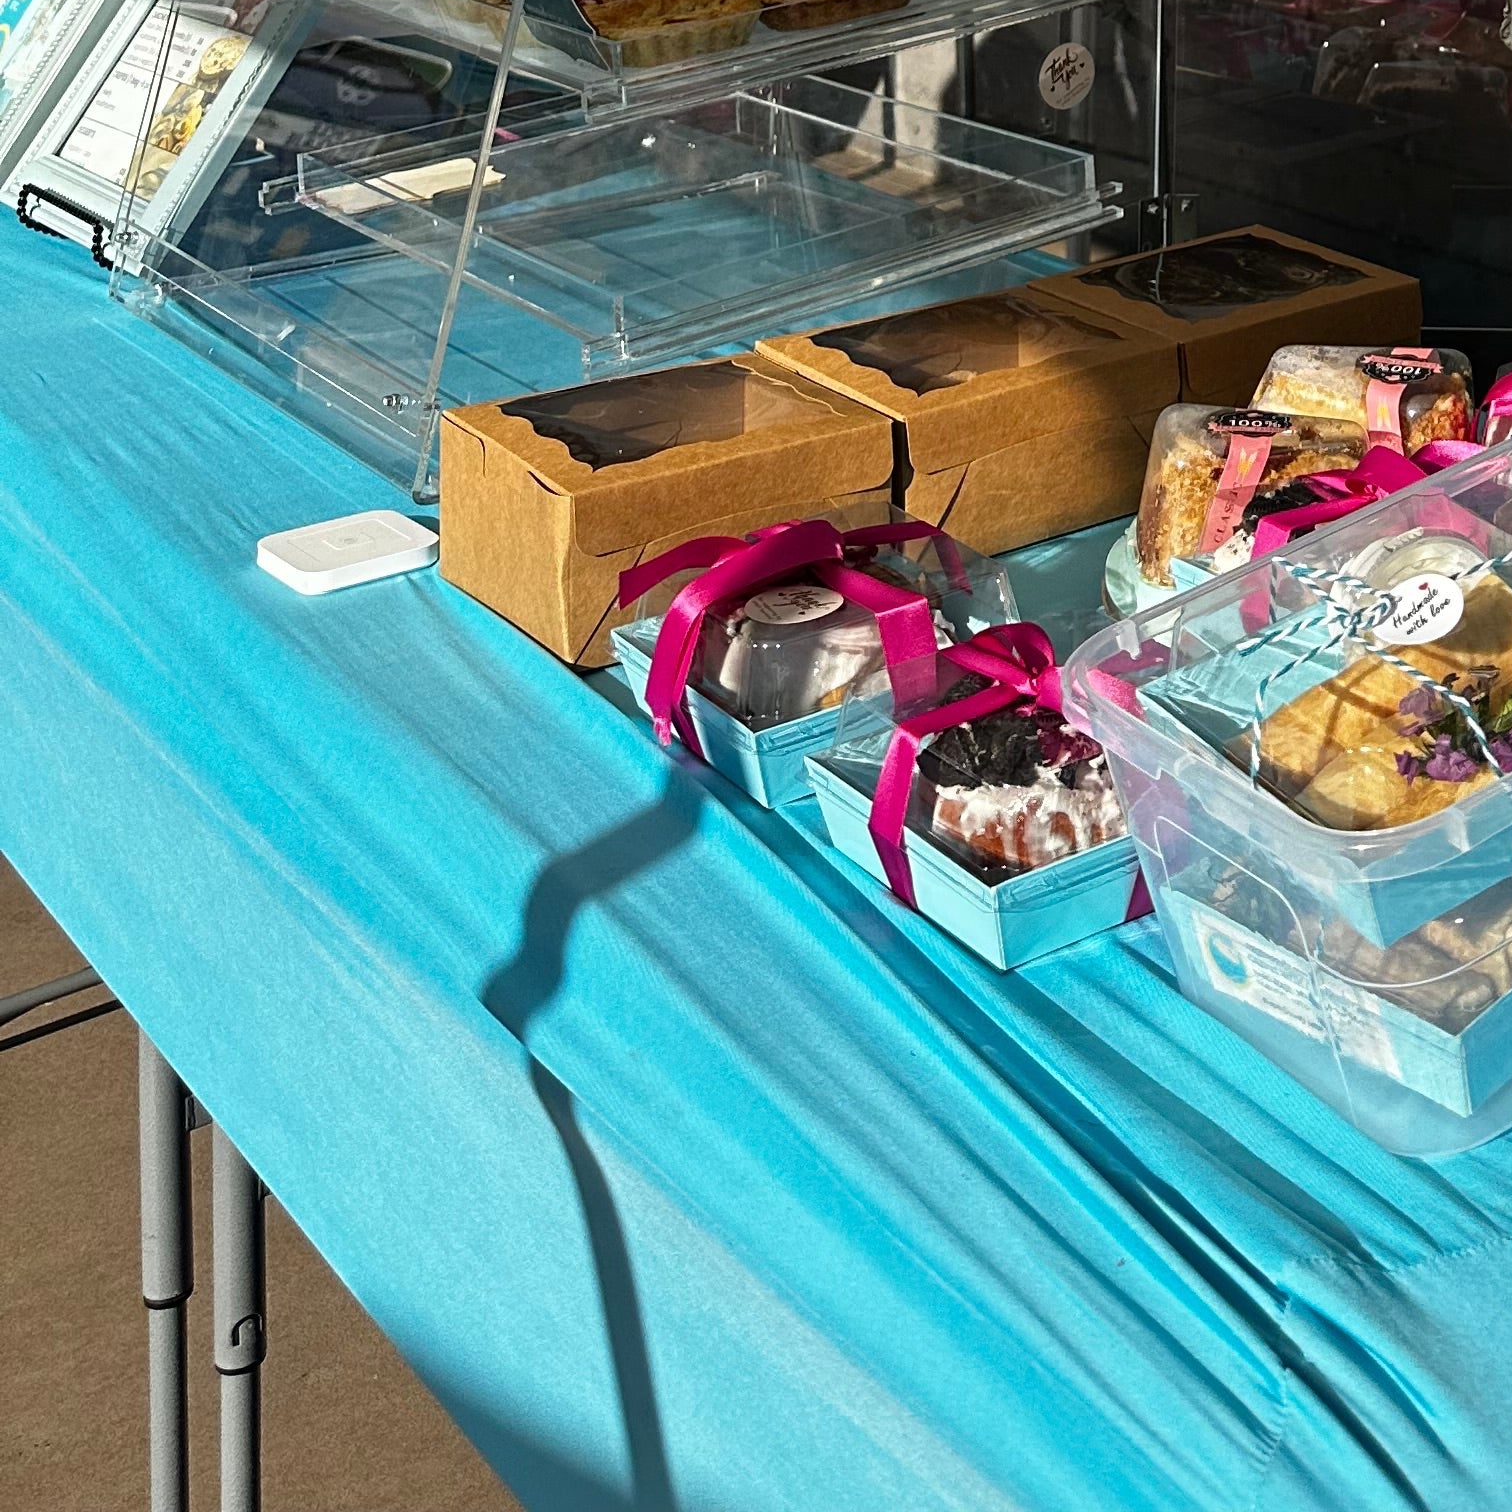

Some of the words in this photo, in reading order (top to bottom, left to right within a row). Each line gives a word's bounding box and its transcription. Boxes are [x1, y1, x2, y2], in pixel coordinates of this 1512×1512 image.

[1229, 419, 1282, 428] 100%
[1214, 481, 1242, 543] CLASIC
[1393, 587, 1438, 628] Handmade
[1406, 615, 1428, 635] with
[1430, 598, 1451, 617] love
